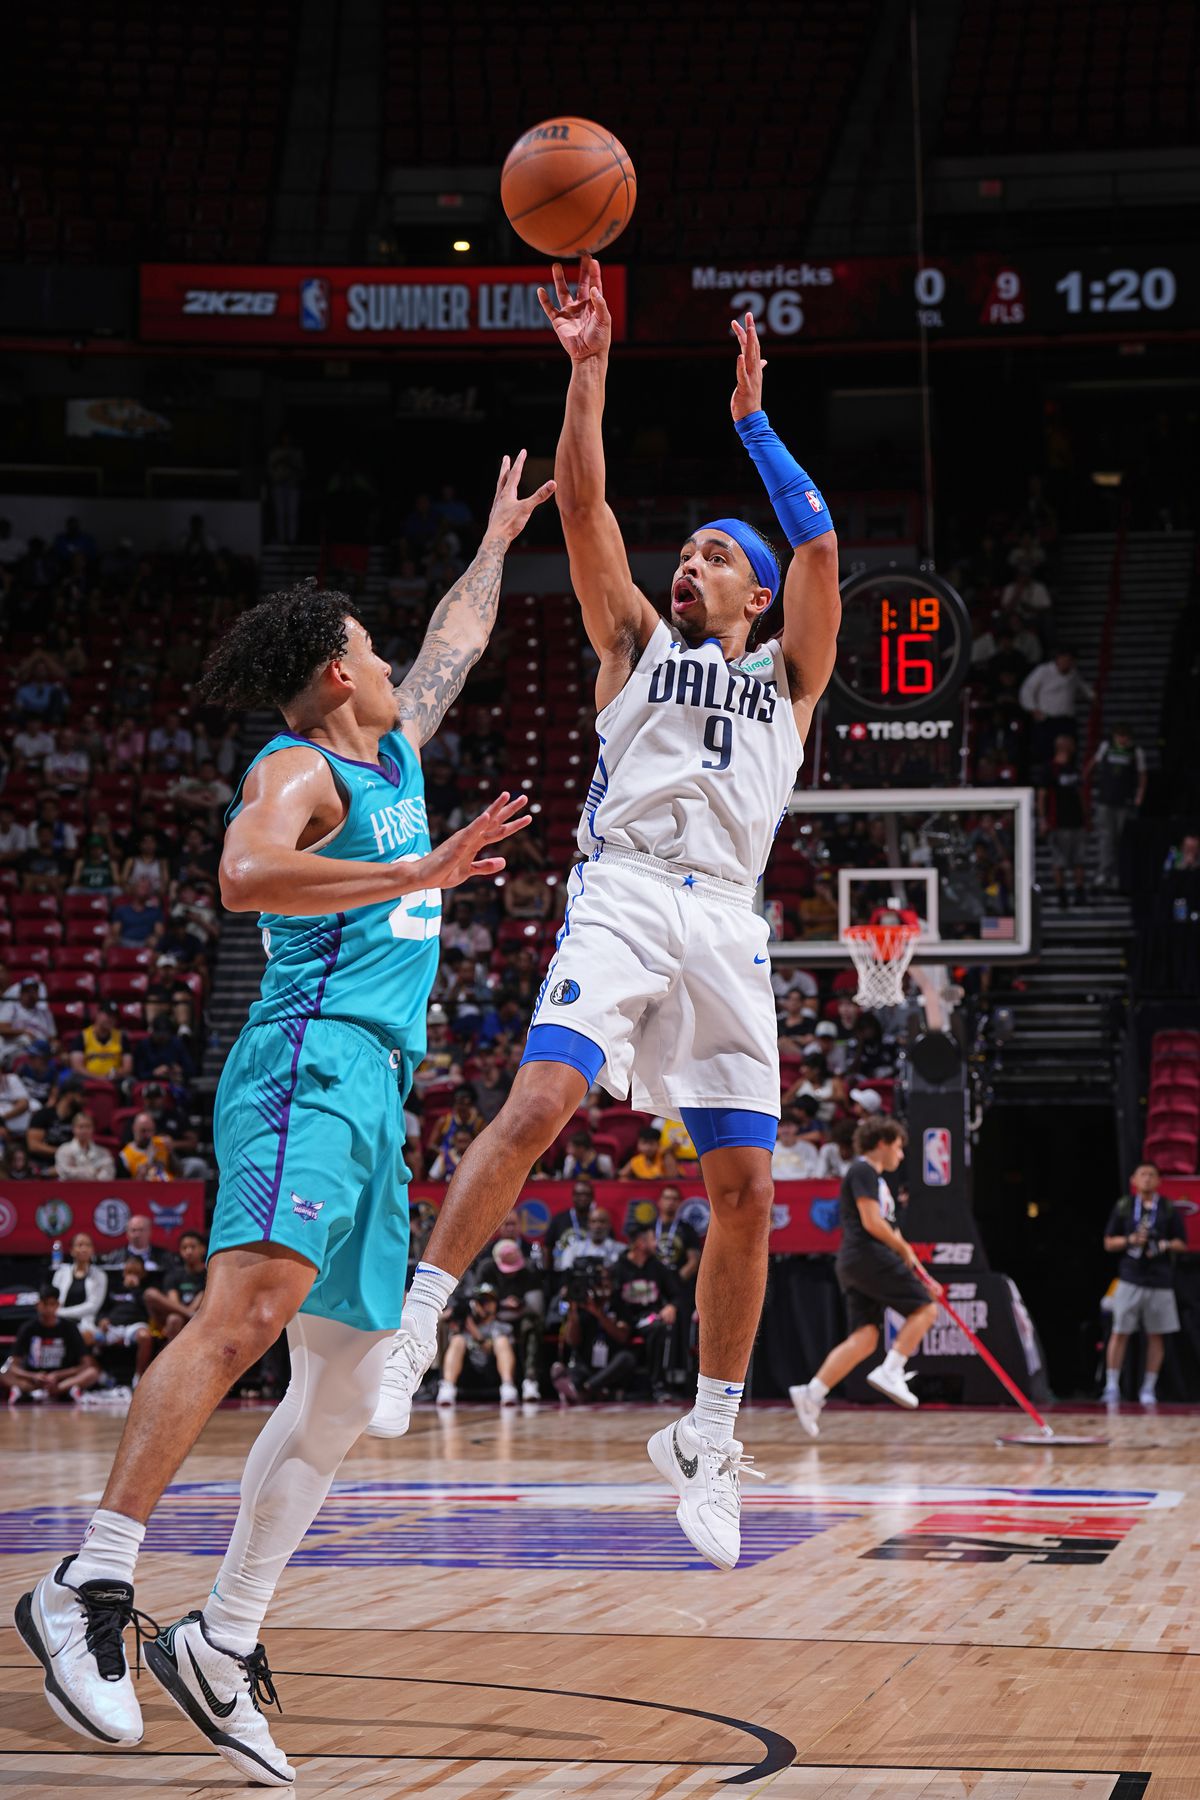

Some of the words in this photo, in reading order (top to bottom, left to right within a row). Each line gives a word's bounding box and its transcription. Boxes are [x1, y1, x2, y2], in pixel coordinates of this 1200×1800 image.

[692, 264, 833, 289] Mavericks
[914, 268, 945, 305] 0
[997, 271, 1020, 300] 9
[1056, 267, 1176, 313] 1:20
[182, 290, 279, 315] 2K26
[347, 283, 470, 331] SUMMER
[478, 282, 579, 330] LEAG
[730, 290, 804, 336] 26
[990, 304, 1024, 323] FLS
[882, 598, 940, 632] 1:19
[738, 656, 773, 674] hime
[881, 633, 933, 695] 16
[648, 659, 777, 723] DALLAS
[702, 715, 733, 771] 9
[867, 720, 953, 740] TISSOT
[910, 1242, 975, 1264] K26
[940, 1282, 977, 1299] 26
